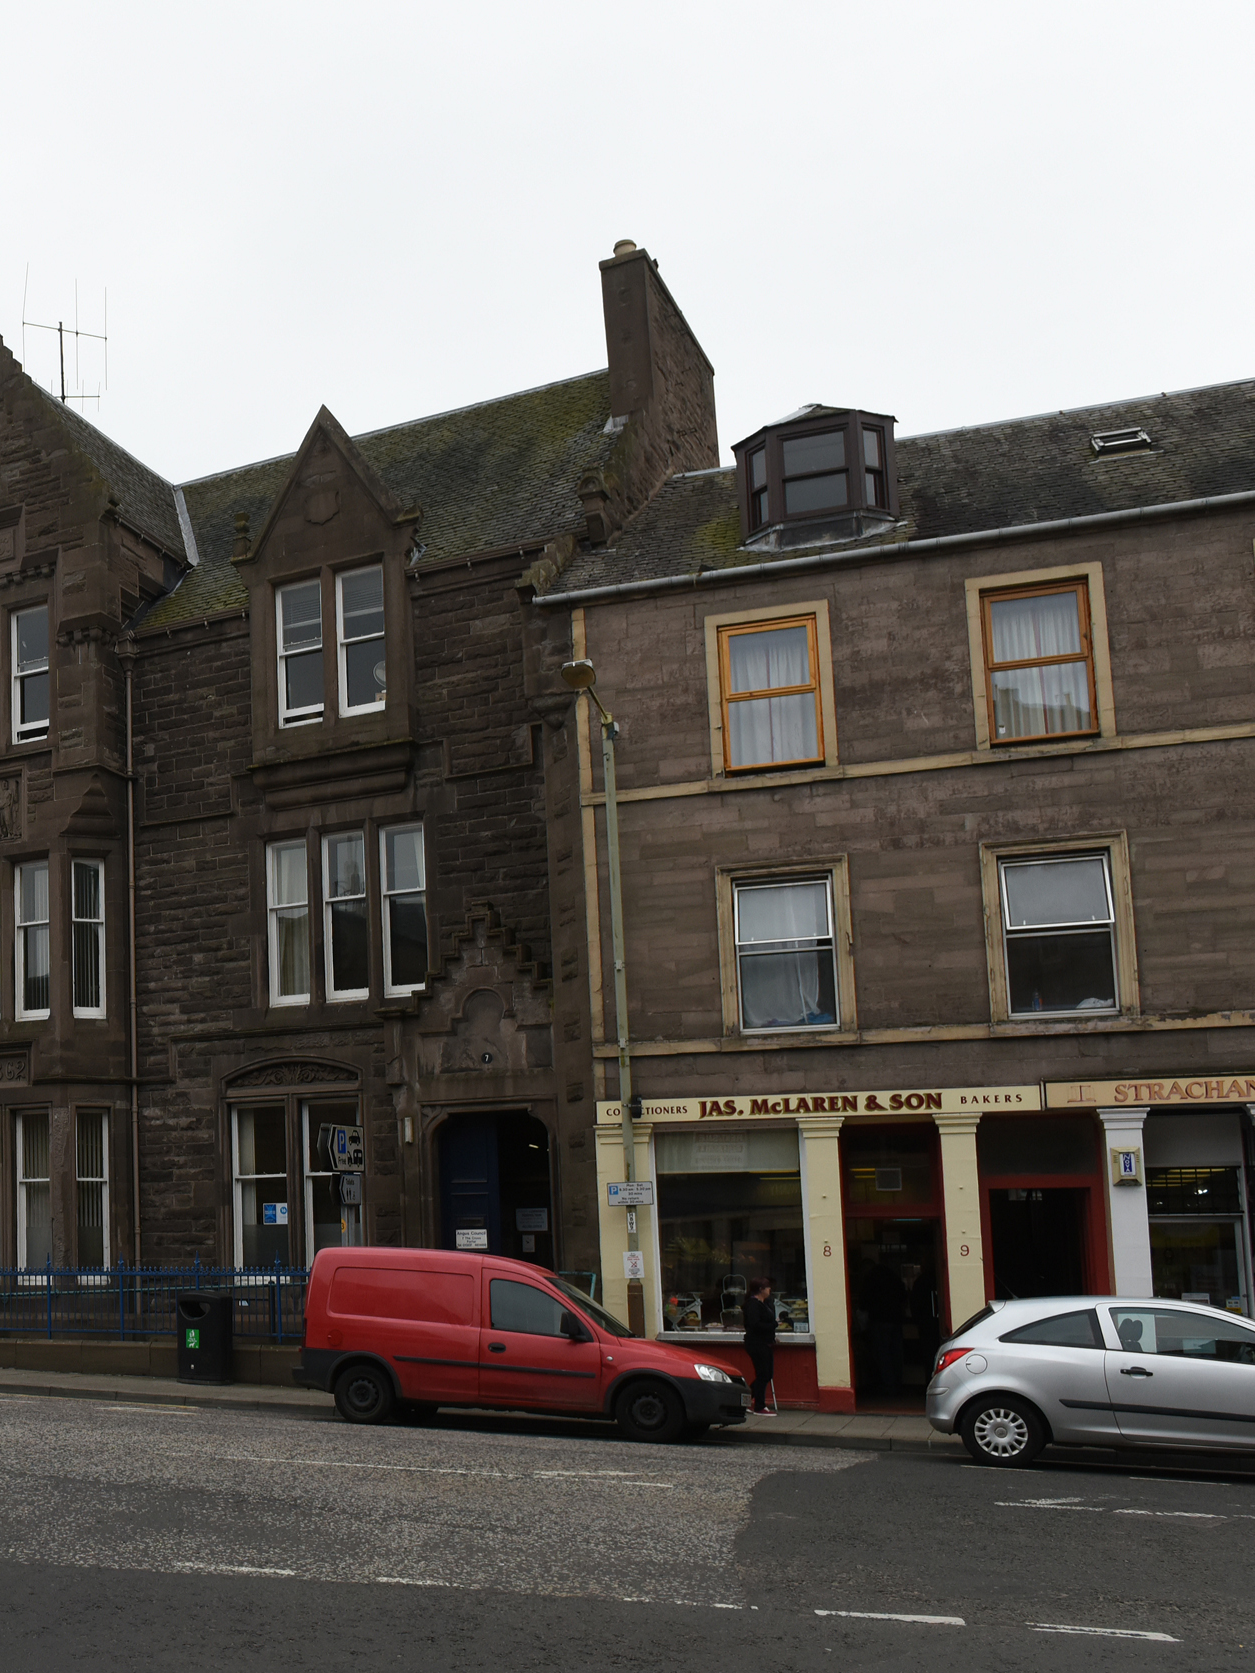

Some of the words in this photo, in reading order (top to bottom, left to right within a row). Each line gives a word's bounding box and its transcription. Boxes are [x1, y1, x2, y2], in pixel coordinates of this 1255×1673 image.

[484, 1054, 489, 1062] 7
[960, 1094, 1023, 1105] BAKERS
[698, 1099, 745, 1119] JAS.
[748, 1095, 859, 1116] McLAREN
[863, 1094, 889, 1112] &
[888, 1092, 943, 1111] SON
[339, 1132, 345, 1151] P
[338, 1156, 346, 1165] Free
[611, 1186, 617, 1194] P
[823, 1245, 832, 1257] 8
[960, 1244, 970, 1257] 9
